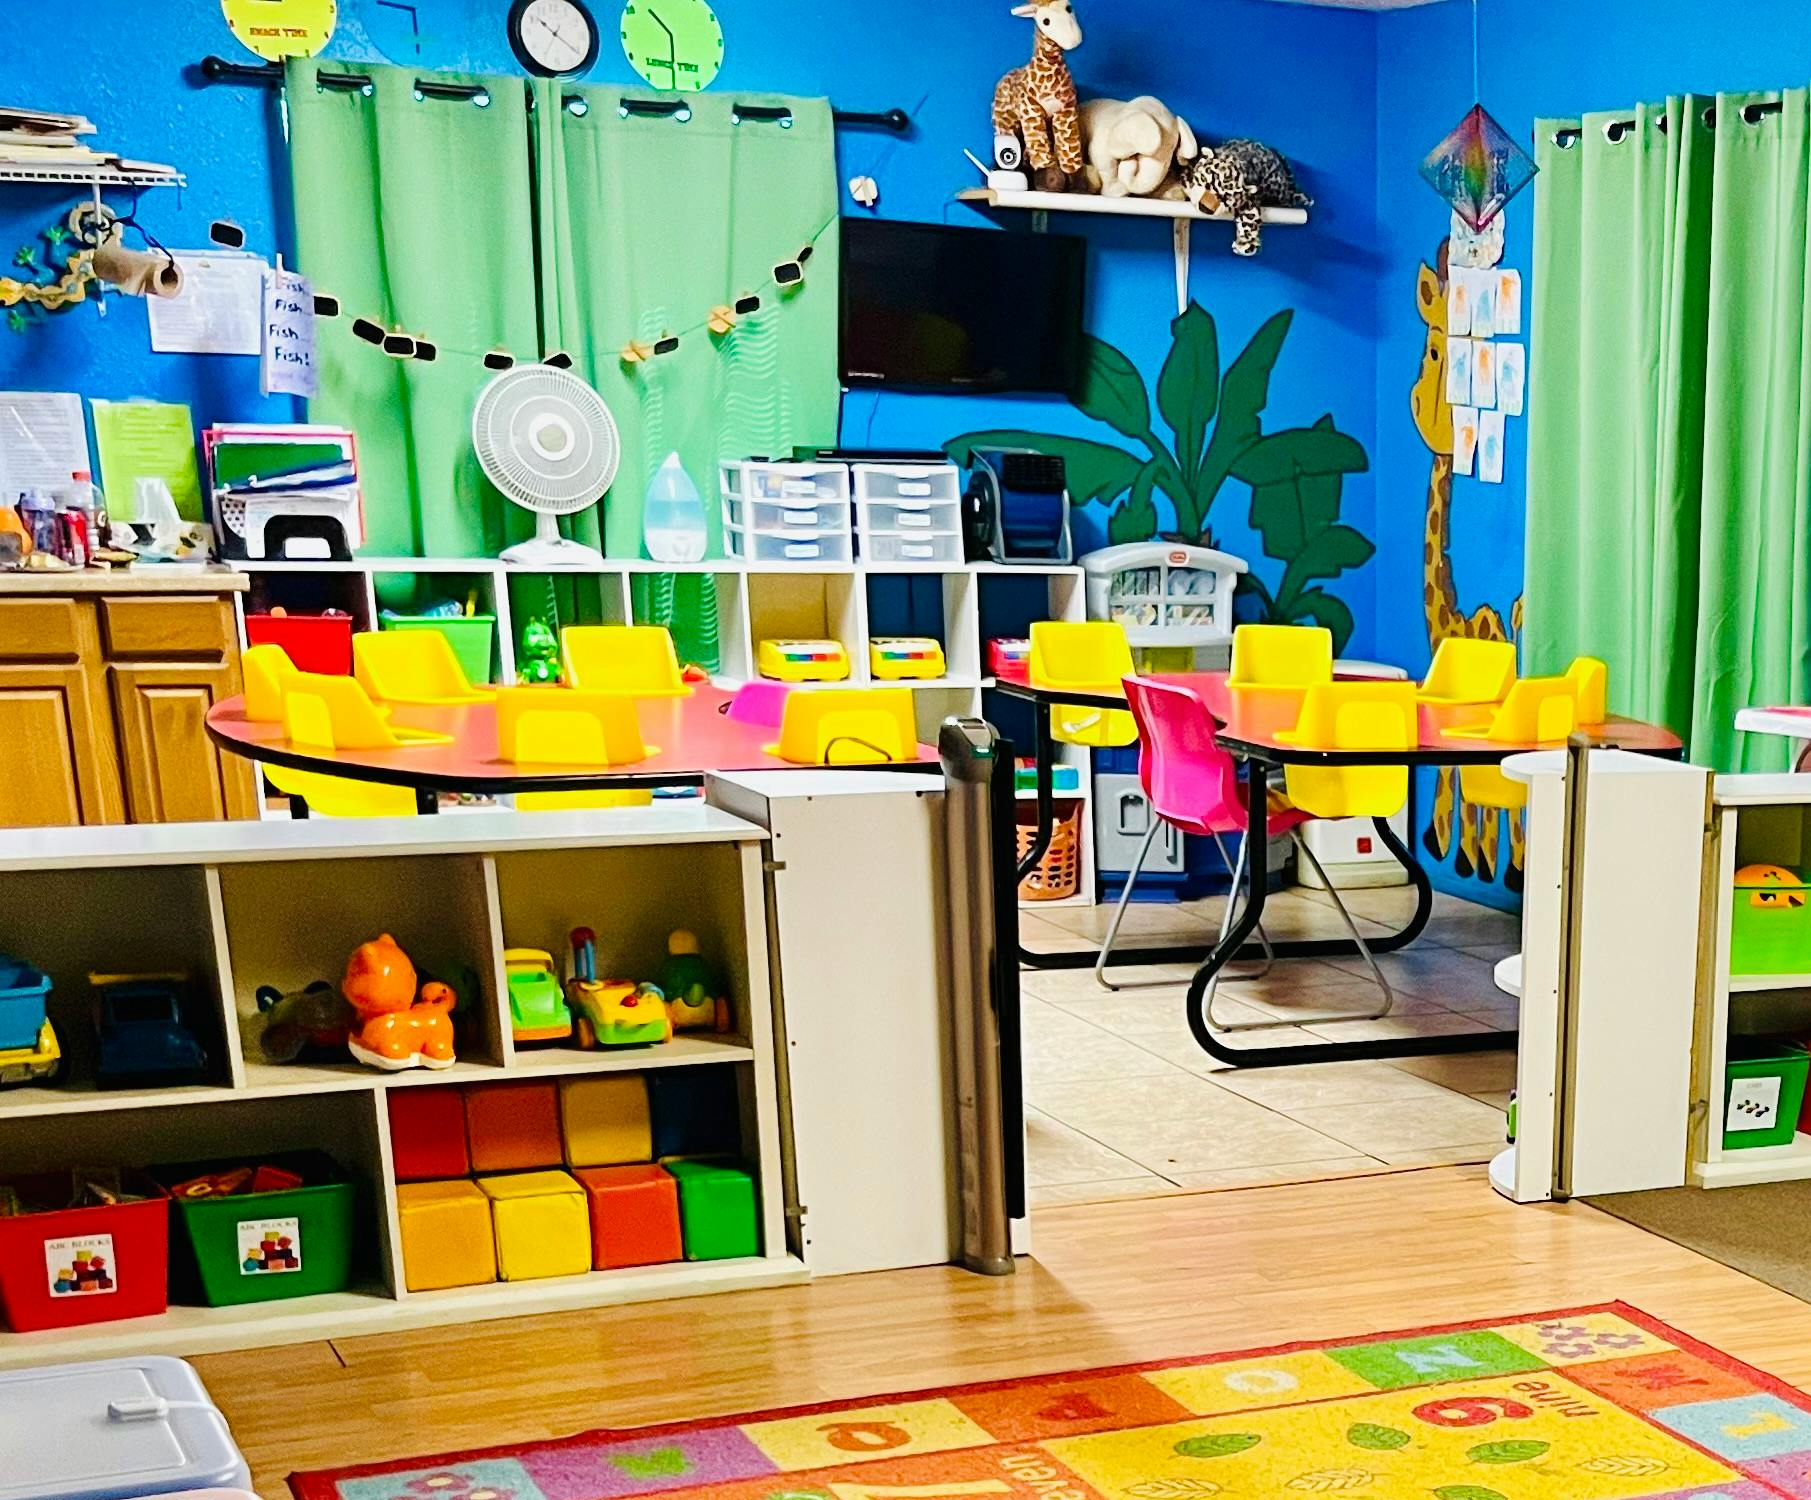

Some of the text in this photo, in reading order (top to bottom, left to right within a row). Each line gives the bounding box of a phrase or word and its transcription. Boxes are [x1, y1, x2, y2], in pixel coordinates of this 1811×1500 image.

[274, 347, 310, 367] Fish!
[1224, 1367, 1300, 1395] O
[1512, 1380, 1600, 1418] nine
[815, 1420, 912, 1452] Q
